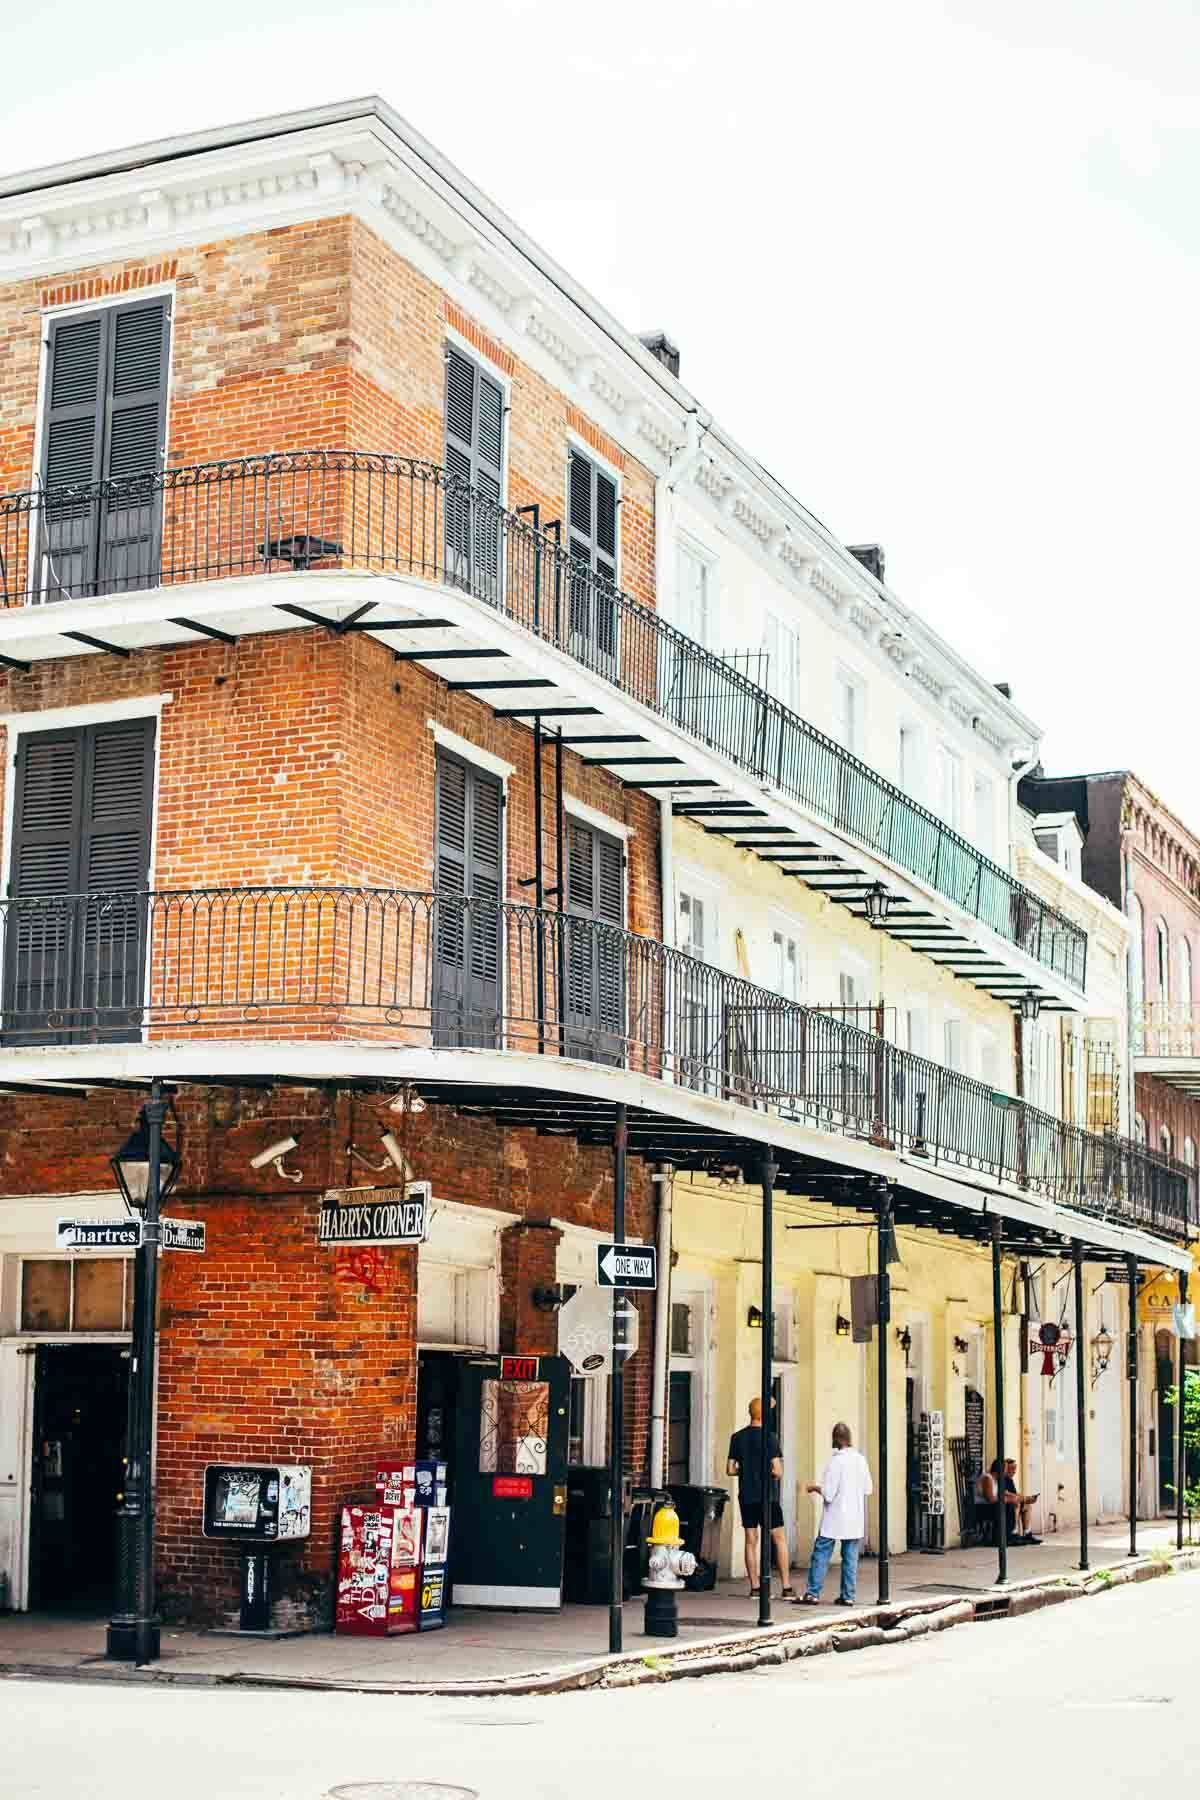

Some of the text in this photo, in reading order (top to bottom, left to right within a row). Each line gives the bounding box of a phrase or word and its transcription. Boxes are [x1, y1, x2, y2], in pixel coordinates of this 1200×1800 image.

[320, 1203, 423, 1239] HARRY'S CORNER
[615, 1257, 650, 1275] ONE WAY
[503, 1359, 535, 1379] EXIT
